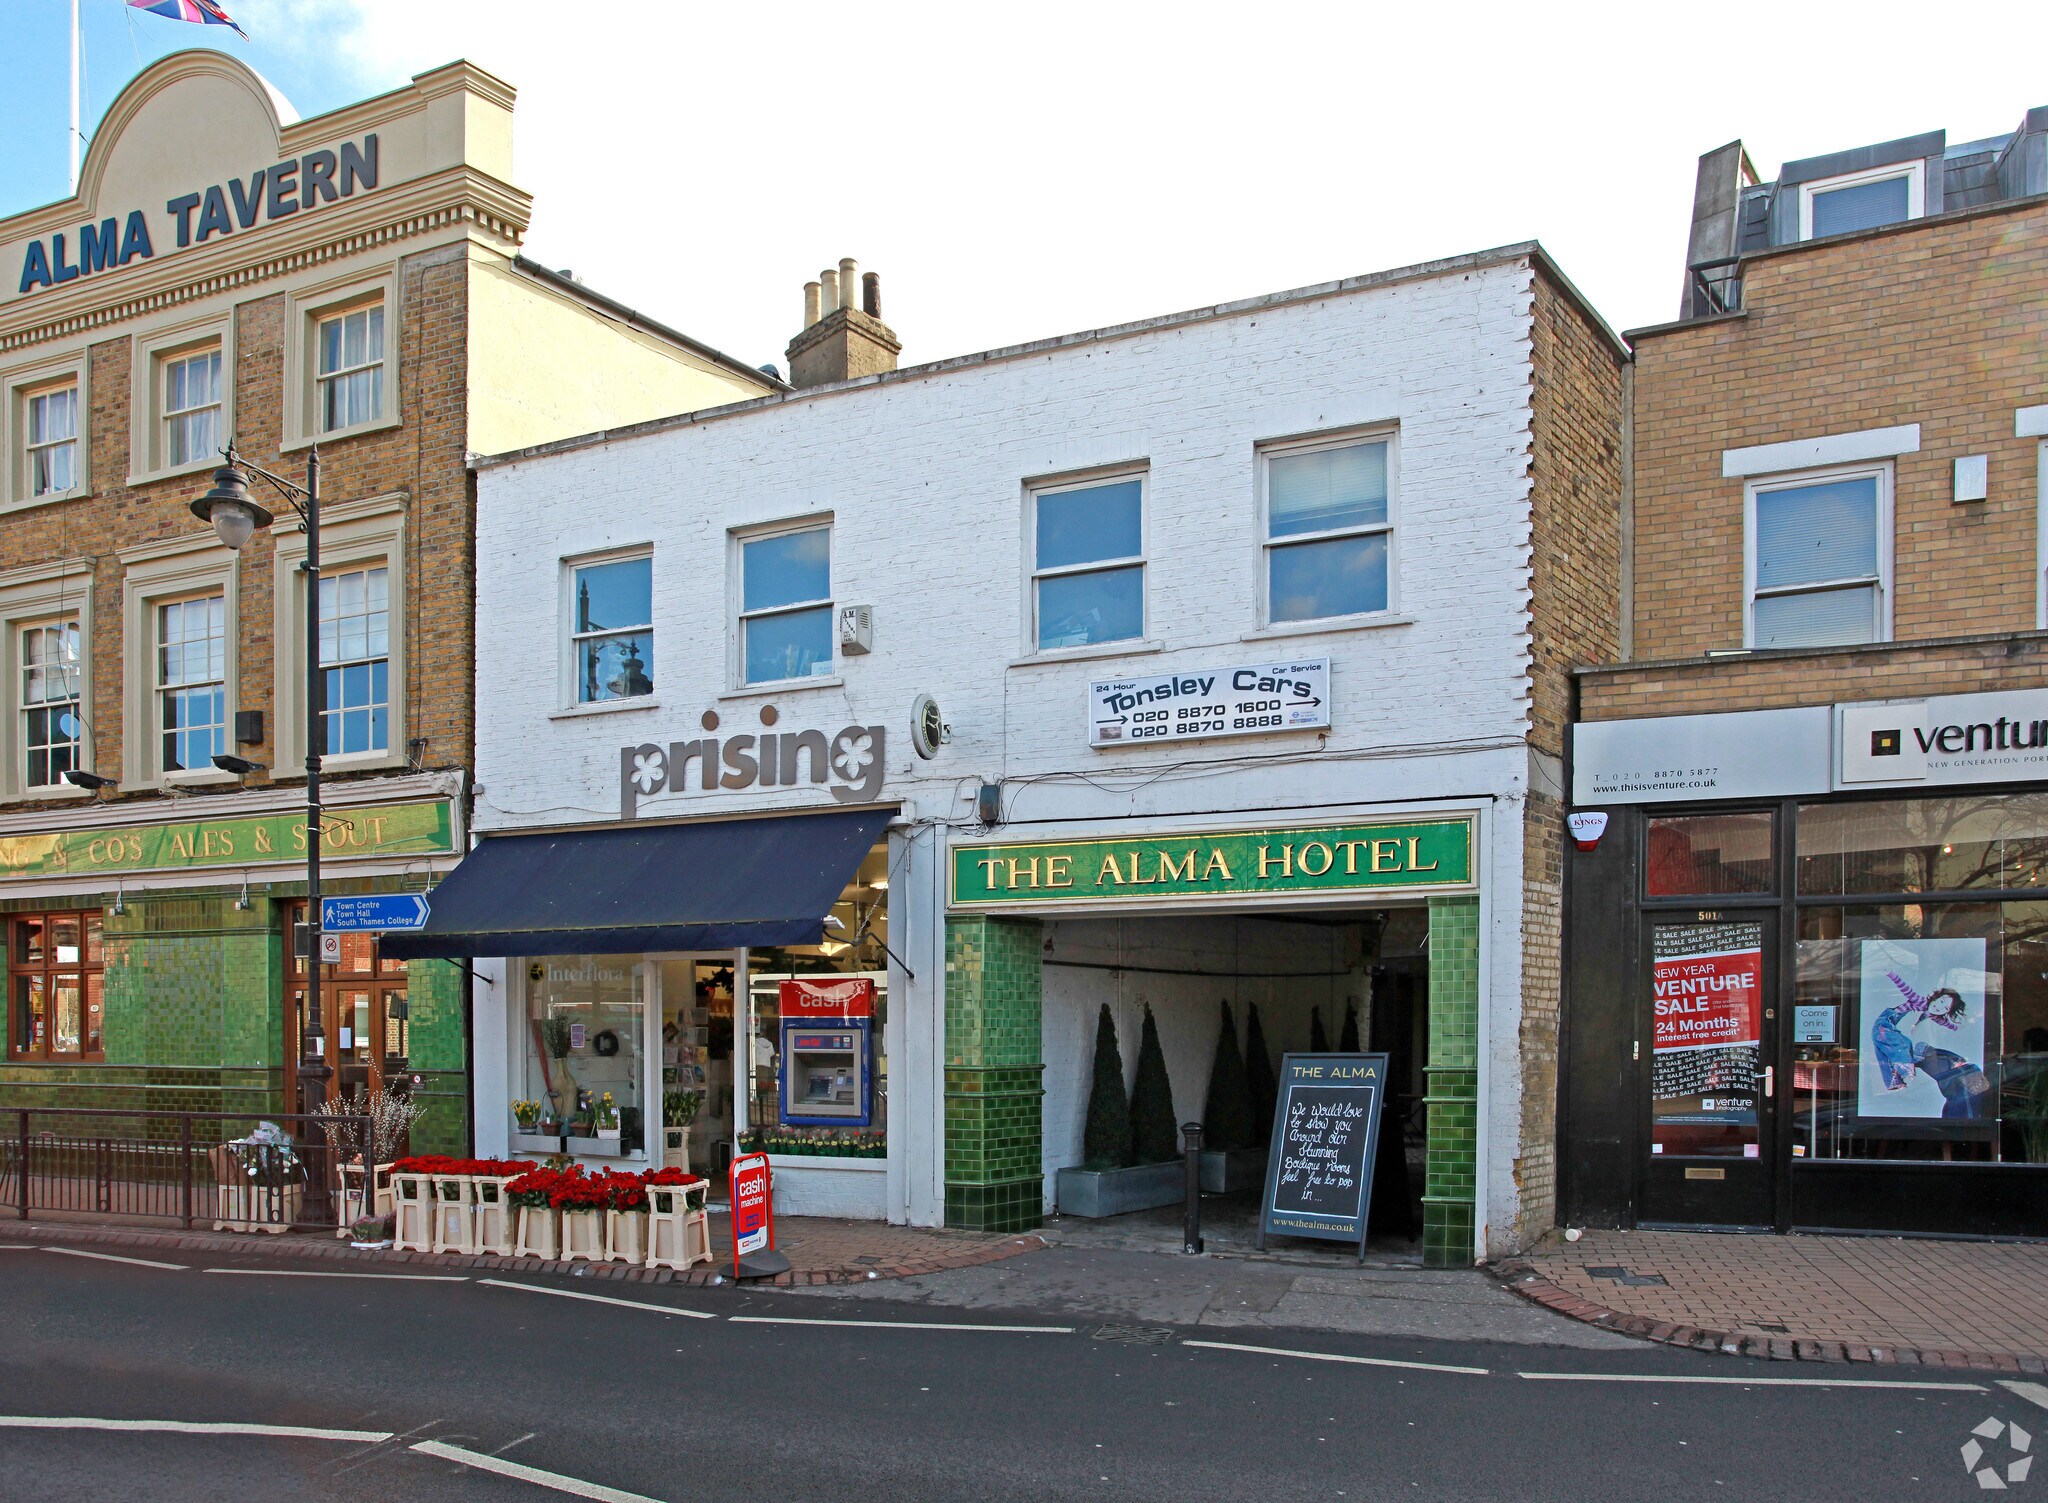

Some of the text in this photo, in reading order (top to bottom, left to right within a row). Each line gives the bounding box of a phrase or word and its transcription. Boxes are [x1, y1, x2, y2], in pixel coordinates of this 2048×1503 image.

[19, 132, 378, 293] ALMA TAVERN
[1272, 663, 1322, 675] Car Service
[1096, 682, 1136, 693] 24 Hour
[1102, 670, 1312, 715] Tonsley Cars
[1132, 699, 1281, 723] 020 8870 1600
[1131, 724, 1168, 738] 020
[1176, 719, 1225, 734] 8870
[1233, 714, 1283, 729] 8888
[620, 704, 885, 820] prising
[1953, 757, 2018, 767] GENERATION
[1654, 770, 1683, 778] 8870
[1689, 767, 1718, 777] 5877
[1593, 779, 1717, 794] www.thisisventure.co.uk
[1574, 818, 1603, 827] KINGS
[53, 842, 68, 867] &
[89, 834, 144, 865] CO'S
[169, 828, 236, 861] ALES
[255, 825, 275, 853] &
[977, 836, 1439, 891] THE ALMA HOTEL
[356, 901, 380, 909] Centre
[356, 909, 371, 917] Hall
[337, 916, 414, 926] South Thames College
[1698, 911, 1723, 921] 501A
[1662, 931, 1678, 939] SALE
[1680, 929, 1696, 937] SALE
[1698, 926, 1714, 935] SALE
[1716, 922, 1734, 931] SALE
[1670, 938, 1685, 946] SALE
[1687, 936, 1703, 944] SALE
[1705, 933, 1722, 941] SALE
[1724, 929, 1741, 937] SALE
[1744, 926, 1761, 934] SALE
[1663, 946, 1679, 954] SALE
[1681, 944, 1696, 952] SALE
[1698, 941, 1714, 949] SALE
[1716, 937, 1733, 946] SALE
[1736, 934, 1754, 942] SALE
[1724, 942, 1741, 950] SALE
[547, 963, 624, 981] Interflora
[1654, 963, 1715, 979] NEW YEAR
[1654, 972, 1755, 997] VENTURE
[800, 988, 848, 1008] cash
[1654, 995, 1710, 1016] SALE
[1800, 1009, 1828, 1017] Come
[1656, 1016, 1739, 1034] 24 Months
[1657, 1031, 1690, 1042] interest
[1691, 1030, 1710, 1039] free
[1657, 1054, 1674, 1062] SALE
[1676, 1051, 1692, 1059] SALE
[1684, 1055, 1700, 1063] SALE
[1702, 1050, 1717, 1058] SALE
[1736, 1047, 1753, 1055] SALE
[1658, 1067, 1675, 1075] SALE
[1678, 1063, 1694, 1071] SALE
[1695, 1058, 1711, 1067] SALE
[1712, 1054, 1728, 1062] SALE
[1666, 1072, 1683, 1080] SALE
[1685, 1067, 1701, 1076] SALE
[1703, 1063, 1718, 1071] SALE
[1738, 1061, 1755, 1069] SALE
[1293, 1067, 1377, 1079] THE ALMA
[1659, 1080, 1676, 1088] SALE
[1679, 1076, 1695, 1084] SALE
[1696, 1071, 1712, 1079] SALE
[1686, 1080, 1702, 1088] SALE
[1704, 1077, 1719, 1085] SALE
[1739, 1076, 1756, 1084] SALE
[1660, 1092, 1677, 1100] SALE
[1679, 1089, 1696, 1097] SALE
[1697, 1085, 1713, 1093] SALE
[1291, 1102, 1307, 1117] We
[1343, 1102, 1364, 1118] love
[1715, 1098, 1753, 1107] venture
[1290, 1116, 1352, 1134] to show you
[1328, 1133, 1348, 1145] our
[1284, 1156, 1351, 1175] Boutique rooms
[739, 1173, 765, 1197] cash
[1324, 1173, 1336, 1186] to
[1337, 1177, 1353, 1191] pop
[741, 1195, 764, 1209] machine
[1273, 1217, 1355, 1233] www.thealma.co.uk
